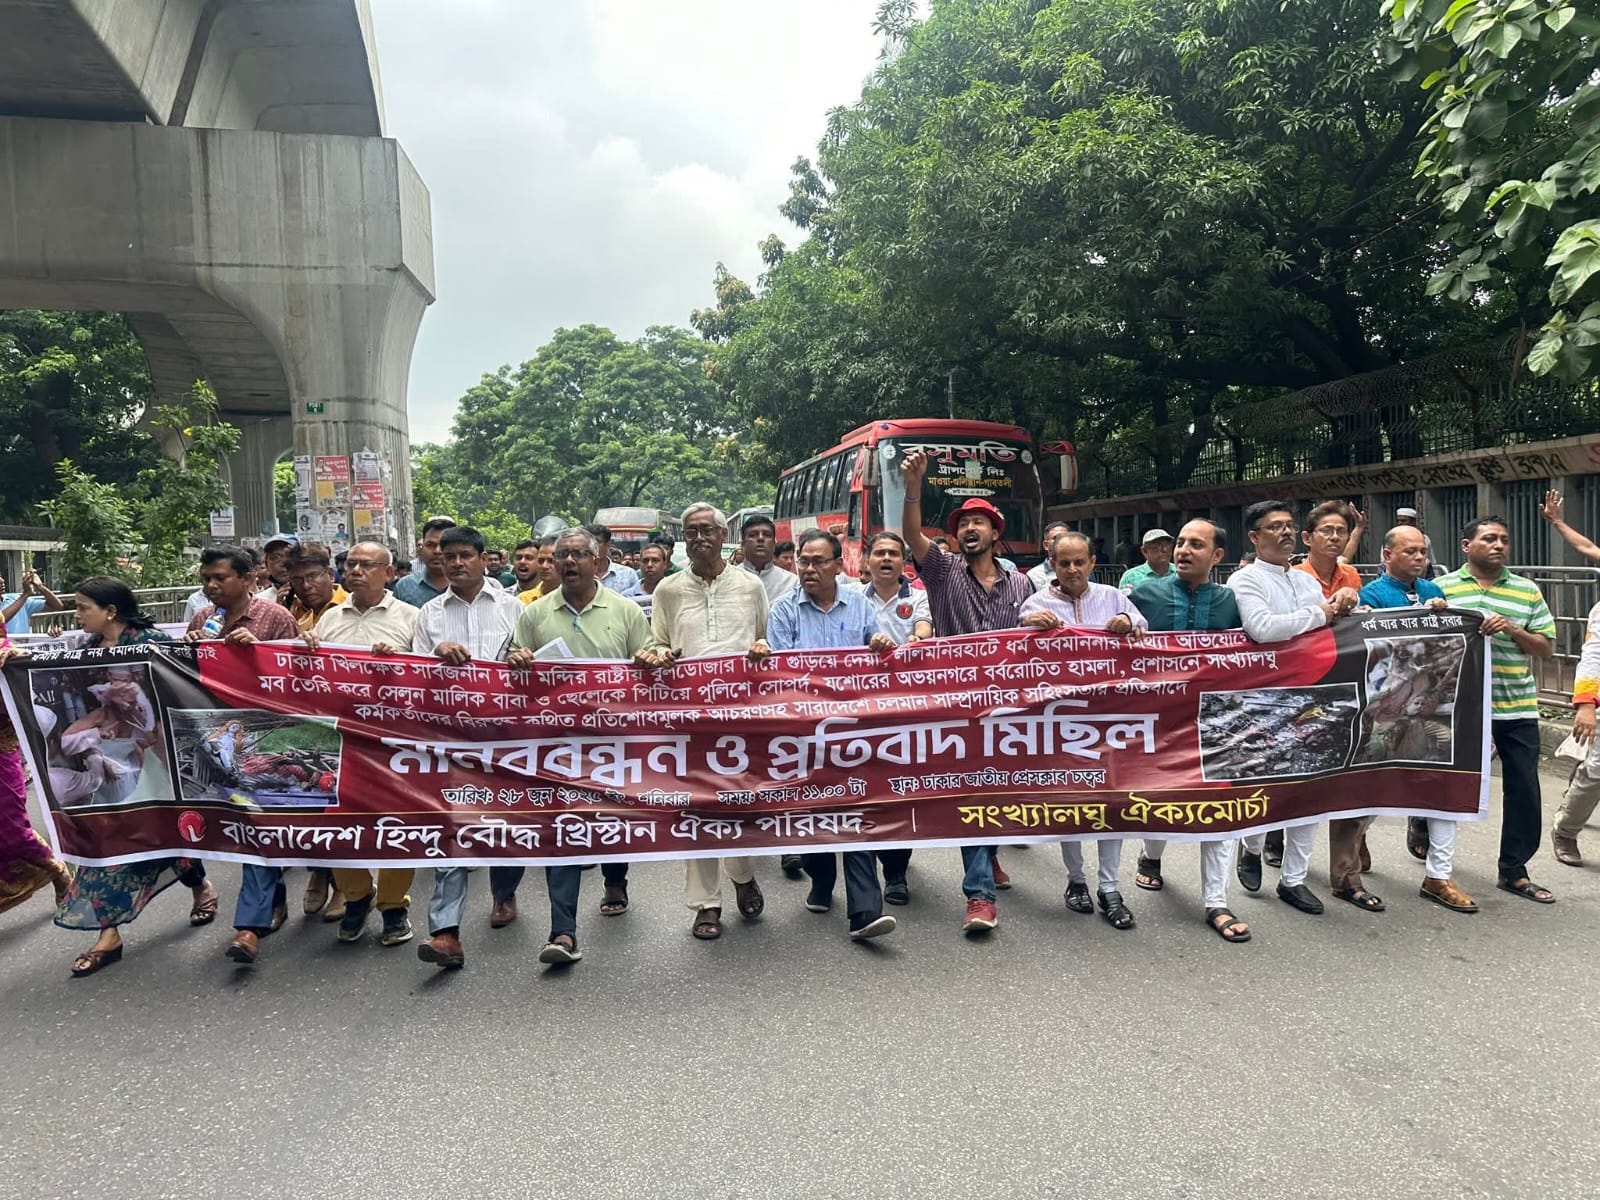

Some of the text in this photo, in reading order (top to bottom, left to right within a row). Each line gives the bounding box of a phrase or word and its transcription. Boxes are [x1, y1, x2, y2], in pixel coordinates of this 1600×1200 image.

[1360, 615, 1463, 631] ধর্ম যার যার রাষ্ট্র সবার
[87, 647, 104, 657] নয়
[196, 646, 219, 661] চাই
[273, 652, 324, 672] ঢাকার
[329, 654, 406, 676] খিলক্ষেত
[410, 660, 491, 684] সার্বজনীন
[536, 665, 587, 686] মন্দির
[591, 664, 643, 684] রাষ্ট্রীয়
[651, 657, 737, 684] বুলডোজার
[893, 637, 1000, 664] লালমনিরহাটে
[1006, 633, 1030, 655] ধর্ম
[1035, 635, 1120, 654] অবমাননার
[258, 676, 286, 693] মব
[288, 674, 332, 694] তৈরি
[334, 681, 372, 698] করে
[378, 685, 426, 706] সেলুন
[431, 685, 486, 708] মালিক
[491, 692, 528, 710] বাবা
[534, 696, 550, 706] ও
[557, 688, 626, 706] ছেলেকে
[633, 683, 692, 701] পিটিয়ে
[698, 678, 752, 704] পুলিশে
[824, 672, 891, 692] যশোরের
[895, 666, 979, 688] অভয়নগরে
[984, 656, 1063, 681] বর্বরোচিত
[1130, 654, 1200, 674] প্রশাসনে
[1206, 651, 1279, 671] সংখ্যালঘু
[354, 702, 451, 726] কর্মকর্তাদের
[521, 709, 576, 728] কথিত
[581, 706, 701, 729] প্রতিশোধমূলক
[706, 702, 790, 722] আচরণসহ
[793, 697, 872, 718] সারাদেশে
[875, 694, 930, 714] চলমান
[931, 684, 1018, 709] সাম্প্রদায়িক
[1023, 680, 1107, 701] সহিংসতার
[1113, 677, 1190, 696] প্রতিবাদে
[380, 700, 1159, 787] মানববন্ধন ও প্রতিবাদ মিছিল
[498, 787, 524, 806] ২৮
[527, 787, 554, 807] জুন
[637, 787, 691, 807] শনিবার
[758, 786, 801, 803] সকাল
[802, 785, 846, 800] ১১.০০
[848, 777, 867, 797] টা
[921, 773, 961, 790] ঢাকার
[964, 767, 1009, 788] জাতীয়
[1012, 769, 1068, 787] প্রেসক্লাব
[1070, 768, 1107, 788] চত্বর
[958, 788, 1271, 831] সংখ্যালঘু ঐক্যমোর্চা
[219, 820, 365, 851] বাংলাদেশ
[375, 817, 447, 858] হিন্দু
[456, 818, 543, 851] বৌদ্ধ
[551, 811, 659, 849] খ্রিস্টান
[670, 810, 744, 841] ঐক্য
[755, 810, 864, 838] পরিষদ
